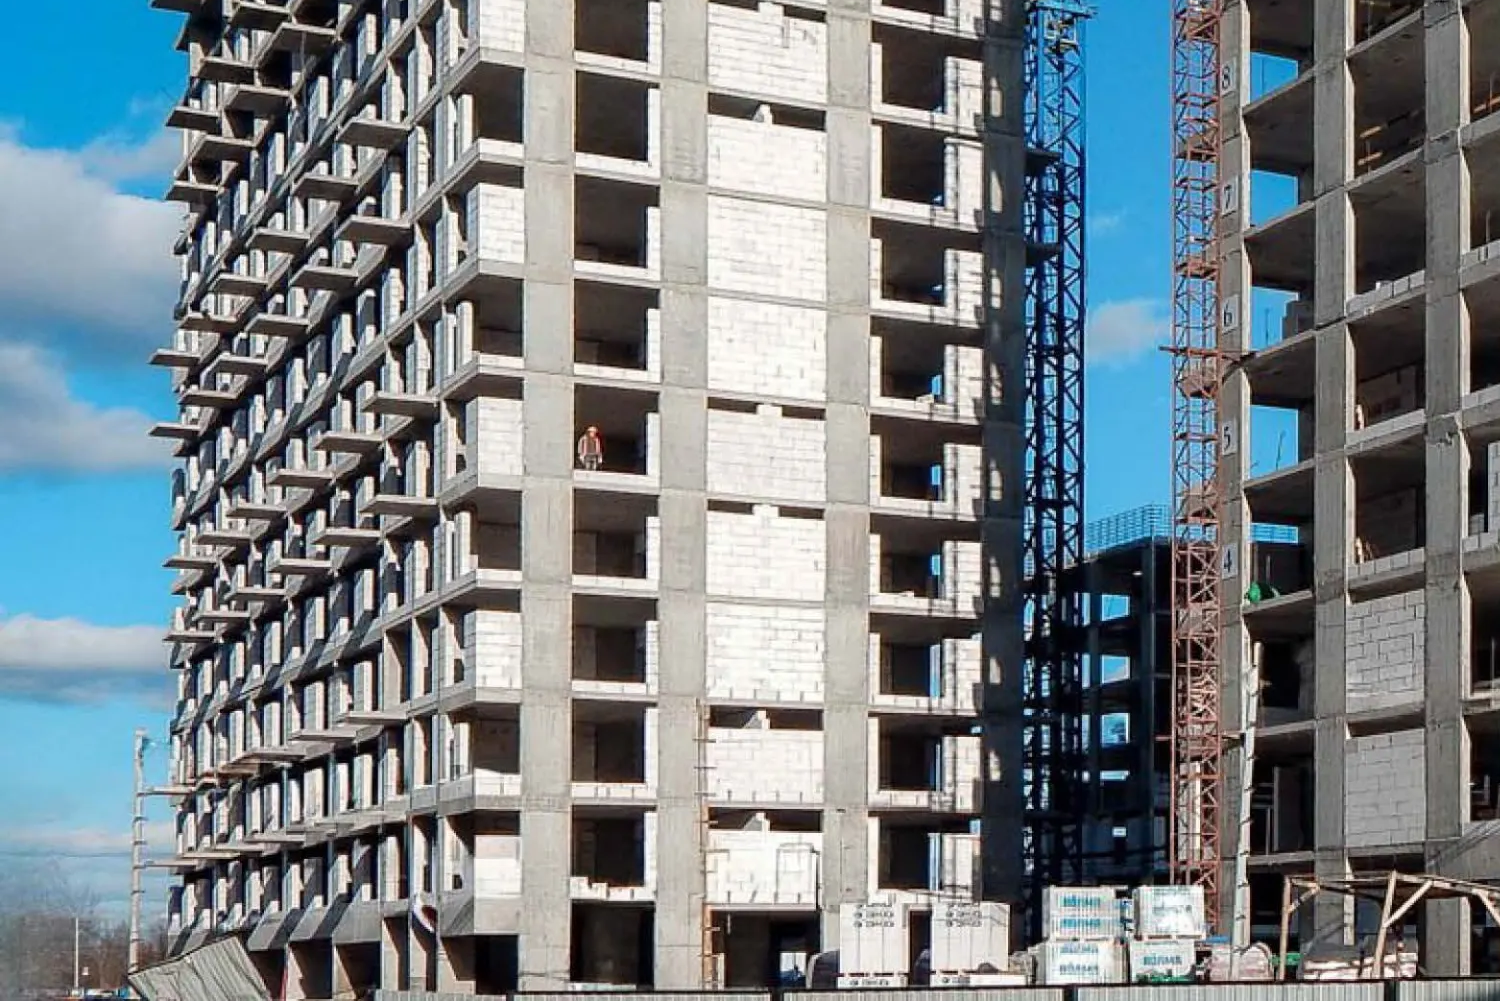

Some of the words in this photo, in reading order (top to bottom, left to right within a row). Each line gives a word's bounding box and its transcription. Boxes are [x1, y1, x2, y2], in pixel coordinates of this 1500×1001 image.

[1222, 65, 1230, 90] 8
[1223, 184, 1232, 209] 7
[1223, 300, 1233, 327] 6
[1223, 425, 1231, 451] 5
[1223, 548, 1232, 573] 4
